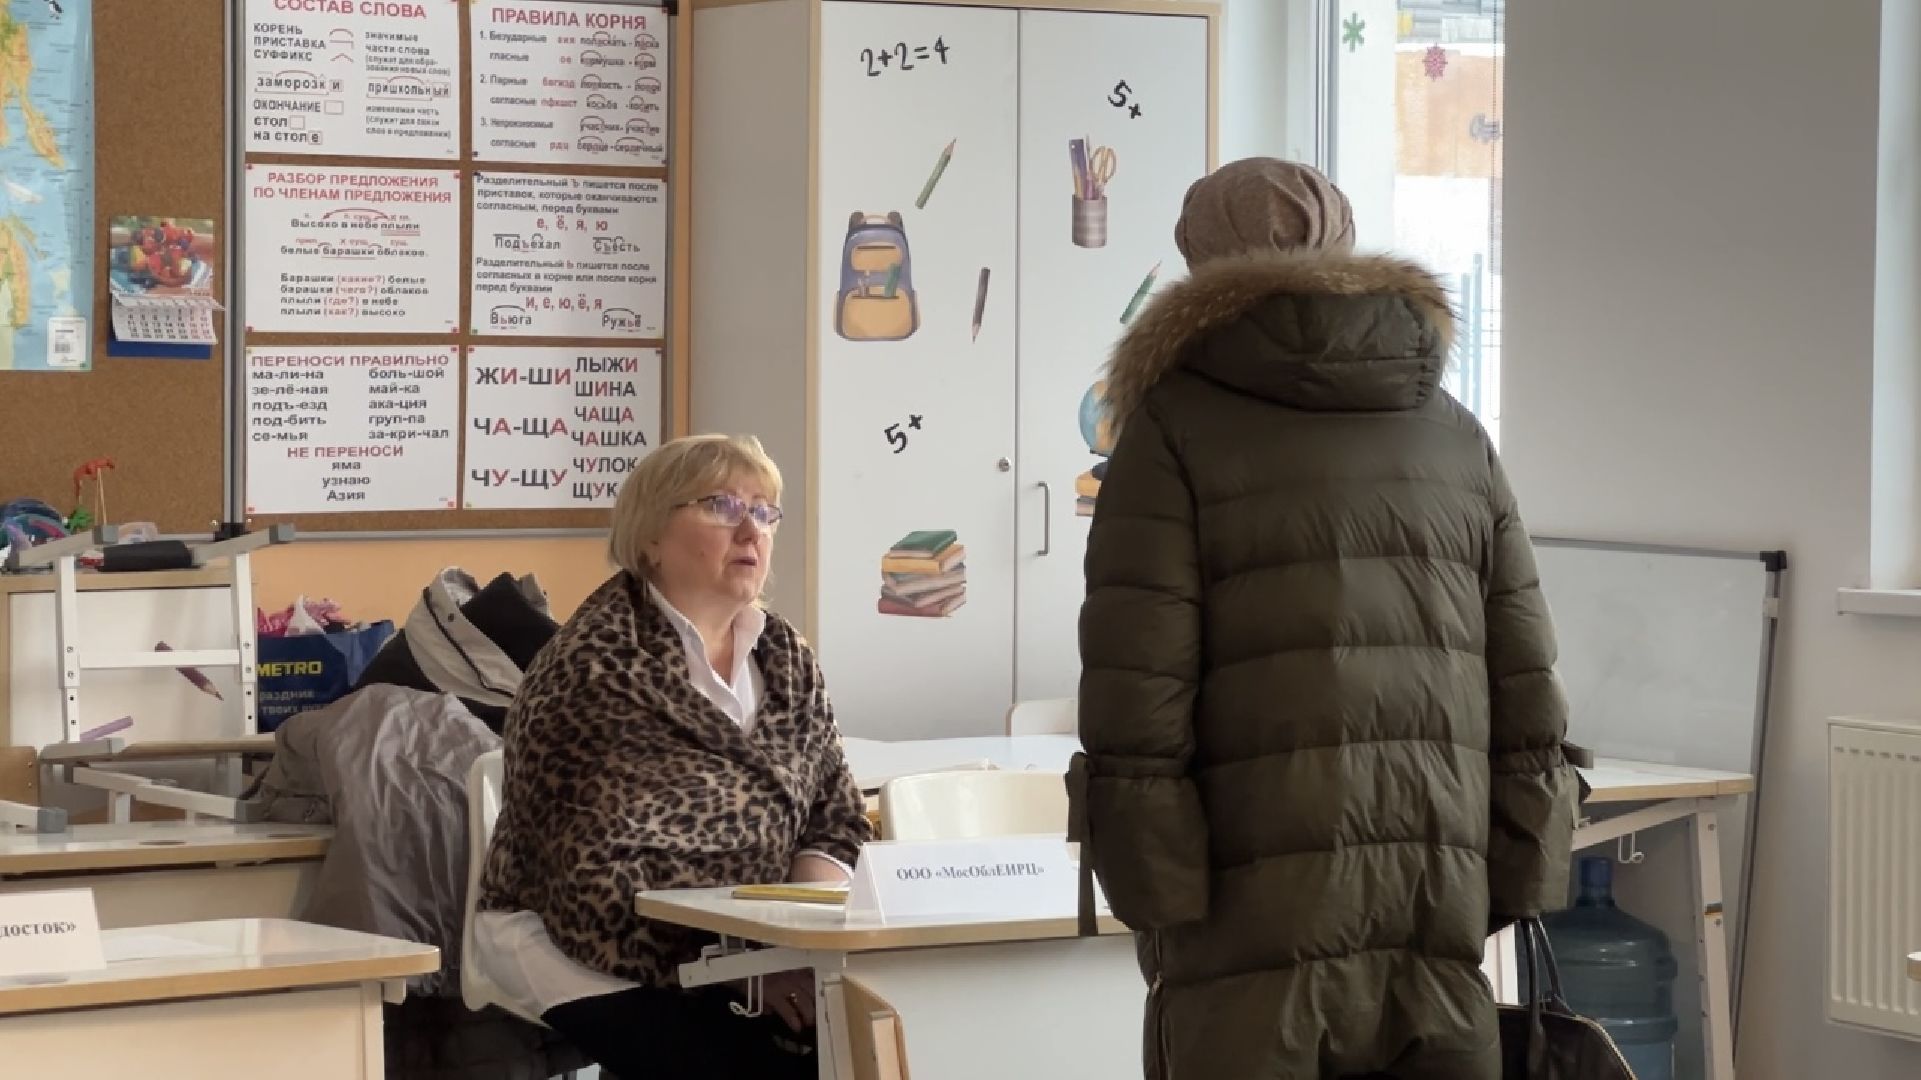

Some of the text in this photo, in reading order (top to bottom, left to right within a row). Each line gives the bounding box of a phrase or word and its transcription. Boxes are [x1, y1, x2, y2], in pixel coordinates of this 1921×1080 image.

[274, 0, 427, 18] СОСТАВ СЛОВА
[491, 7, 647, 29] ПРАВИЛА КОРНЯ
[253, 23, 303, 35] КОРЕНЬ
[253, 37, 326, 50] ПРИСТАВКА
[253, 49, 312, 61] СУФФИКС
[861, 35, 950, 76] 2+2=4
[253, 100, 321, 113] ОКОНЧАНИЕ
[253, 131, 270, 141] на
[268, 172, 439, 188] РАЗБОР ПРЕДЛОЖЕНИЯ
[477, 175, 568, 188] Разделительный
[582, 180, 626, 191] пишется
[628, 182, 659, 191] после
[253, 187, 452, 203] ПО ЧЛЕНАМ ПРЕДЛОЖЕНИЯ
[539, 191, 583, 202] которые
[476, 202, 539, 213] согласным,
[541, 204, 574, 215] перед
[290, 218, 339, 229] Высоко
[350, 220, 379, 230] небе
[494, 236, 561, 250] Подъехал
[280, 246, 320, 256] белые
[322, 247, 375, 257] барашки
[476, 257, 566, 269] Разделительный
[576, 262, 618, 272] пишется
[621, 263, 650, 271] после
[280, 272, 334, 284] Барашки
[387, 275, 427, 285] белые
[476, 271, 533, 281] согласных
[543, 273, 574, 284] корне
[596, 275, 626, 283] после
[280, 285, 333, 295] барашки
[475, 282, 553, 294] перед буквами
[280, 297, 321, 305] плыли
[371, 297, 398, 306] небе
[280, 308, 321, 316] плыли
[361, 309, 406, 317] высоко
[490, 312, 642, 329] Вьюга Ружьё
[251, 355, 449, 367] ПЕРЕНОСИ ПРАВИЛЬНО
[575, 356, 638, 373] ЛЫЖИ
[252, 371, 324, 379] ма-ли-на
[368, 367, 445, 379] боль-шой
[475, 366, 571, 385] ЖИ-ШИ
[252, 384, 329, 395] зе-лё-ная
[368, 382, 421, 394] май-ка
[575, 380, 637, 397] ШИНА
[252, 401, 328, 412] подъ-езд
[368, 400, 427, 411] ака-ция
[252, 414, 327, 427] под-бить
[368, 415, 426, 427] груп-па
[574, 405, 634, 424] ЧАЩА
[368, 428, 449, 440] за-кри-чал
[474, 417, 568, 439] ЧА-ЩА
[252, 432, 309, 441] се-мья
[571, 429, 647, 446] ЧАШКА
[287, 445, 404, 458] НЕ ПЕРЕНОСИ
[331, 461, 361, 470] яма
[572, 456, 638, 473] ЧУЛОК
[322, 477, 371, 488] узнаю
[471, 468, 568, 489] ЧУ-ЩУ
[327, 490, 366, 501] Азия
[257, 661, 322, 676] METRO
[896, 862, 1045, 881] ООО «МосОблЕИРЦ»
